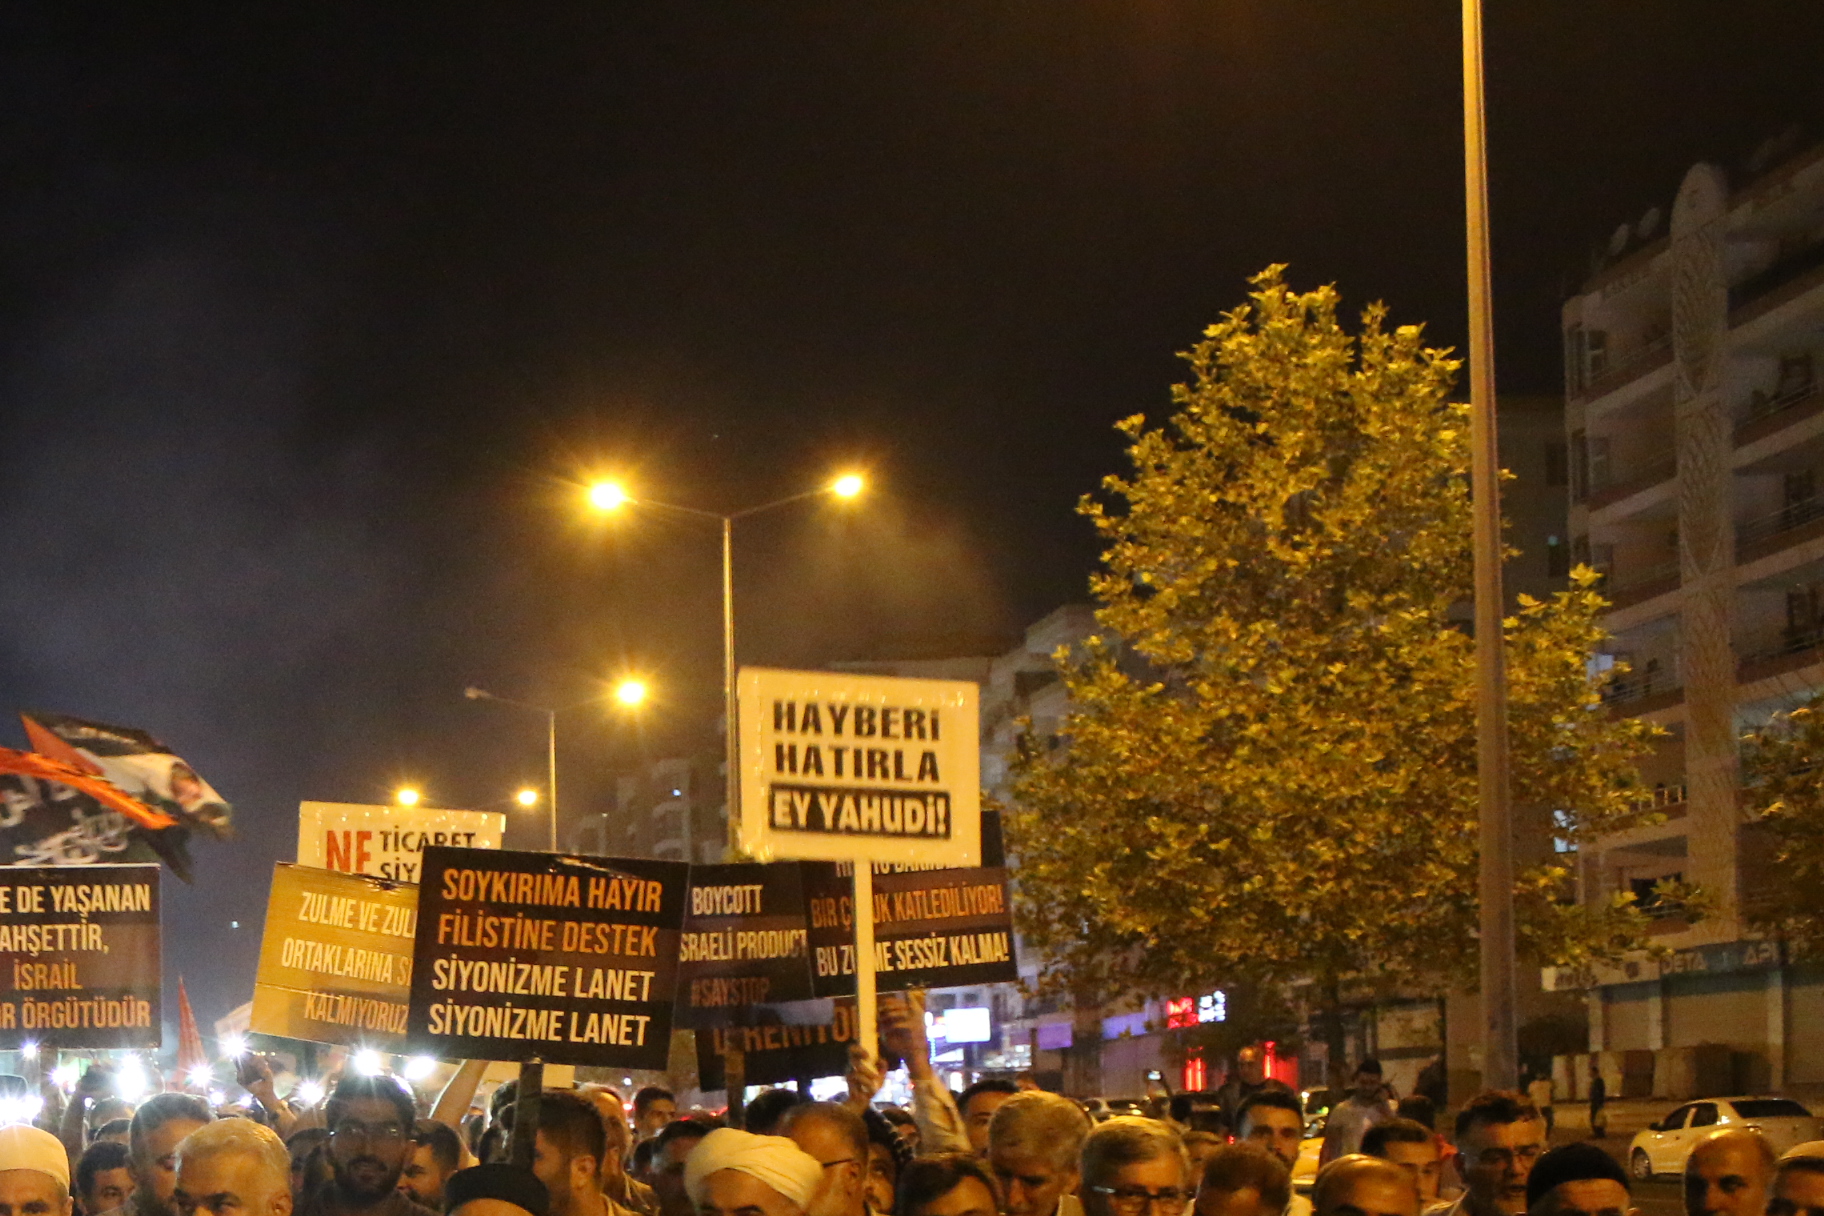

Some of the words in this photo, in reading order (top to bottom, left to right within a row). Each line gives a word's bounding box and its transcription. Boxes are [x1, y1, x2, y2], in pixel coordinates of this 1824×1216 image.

[775, 743, 940, 783] HATIRLA
[774, 790, 812, 829] EY
[818, 791, 946, 835] YAHUDİ!
[326, 830, 372, 874] NE
[380, 856, 417, 883] SİY
[17, 886, 45, 913] DE
[49, 883, 151, 918] YAŞANAN
[442, 868, 581, 908] SOYKIRIMA
[587, 876, 663, 913] HAYIR
[692, 884, 763, 916] BOYCOTT
[894, 881, 1005, 922] KATLEDİLİYOR!
[298, 891, 356, 929] ZULME
[359, 900, 381, 932] VE
[381, 904, 418, 939] ZUL
[438, 908, 556, 952] FİLİSTİNE
[562, 920, 659, 957] DESTEK
[281, 937, 393, 984] ORTAKLARINA
[679, 925, 734, 962] SRAELİ
[817, 945, 839, 976] BU
[895, 932, 949, 971] SESSİZ
[949, 931, 1011, 966] KALMA!
[13, 958, 84, 990] İSRAİL
[432, 952, 569, 998] SİYONİZME
[575, 967, 656, 1002] LANET
[22, 995, 152, 1029] ÖRGÜTÜDÜR
[304, 989, 409, 1034] KALMIYORUZ
[428, 998, 564, 1042] SİYONİZME
[569, 1011, 652, 1046] LANET
